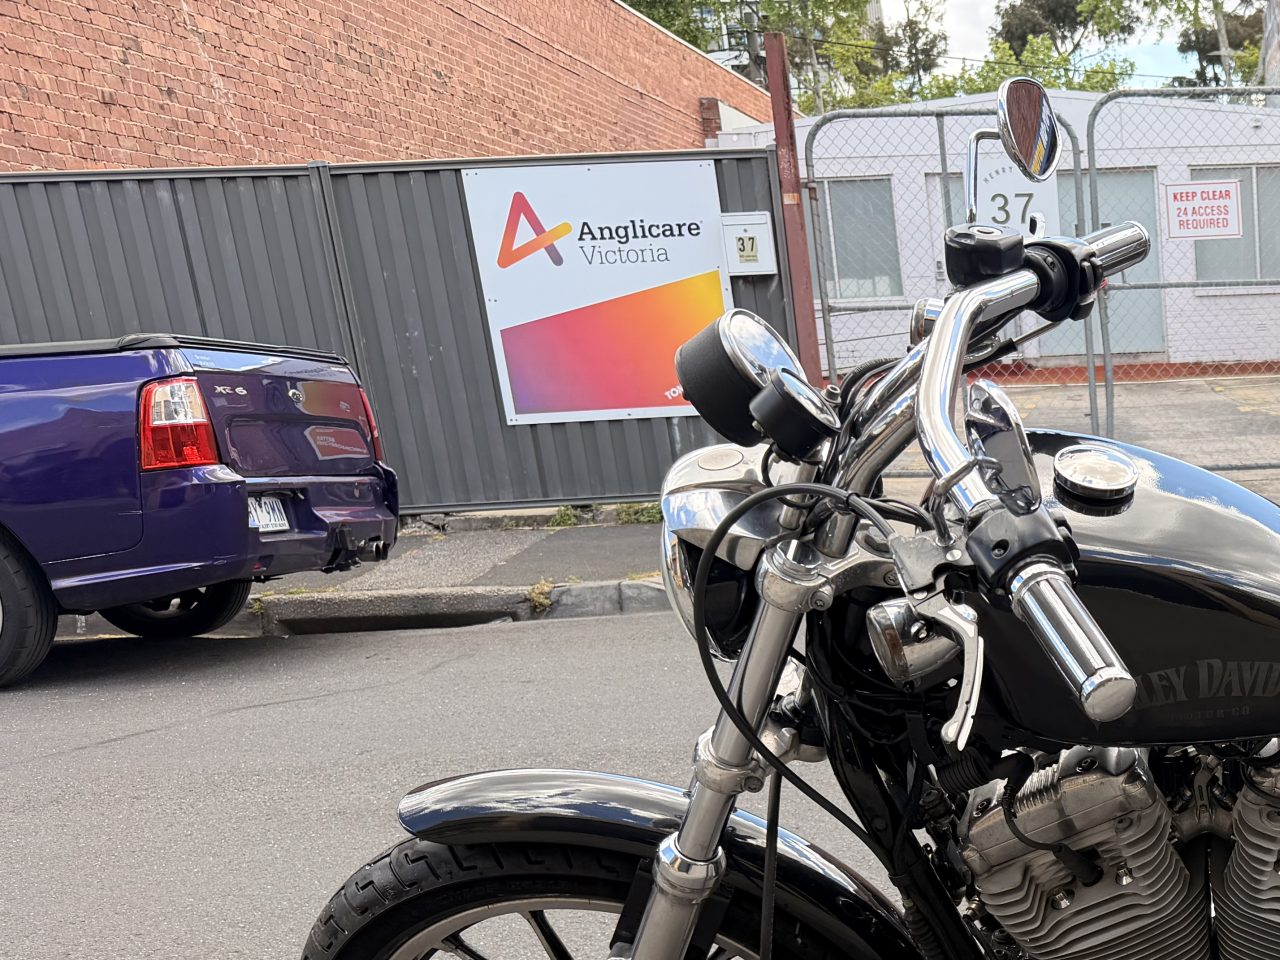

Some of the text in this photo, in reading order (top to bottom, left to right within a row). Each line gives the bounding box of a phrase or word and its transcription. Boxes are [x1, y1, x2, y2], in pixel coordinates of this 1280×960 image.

[1173, 189, 1231, 202] KEEP CLEAR
[990, 193, 1034, 225] 37
[1176, 205, 1229, 217] 24 ACCESS
[578, 219, 701, 244] Anglicare
[1179, 218, 1229, 230] REQUIRED
[737, 236, 755, 252] 37
[578, 243, 671, 265] Victoria
[1135, 665, 1188, 710] LEY
